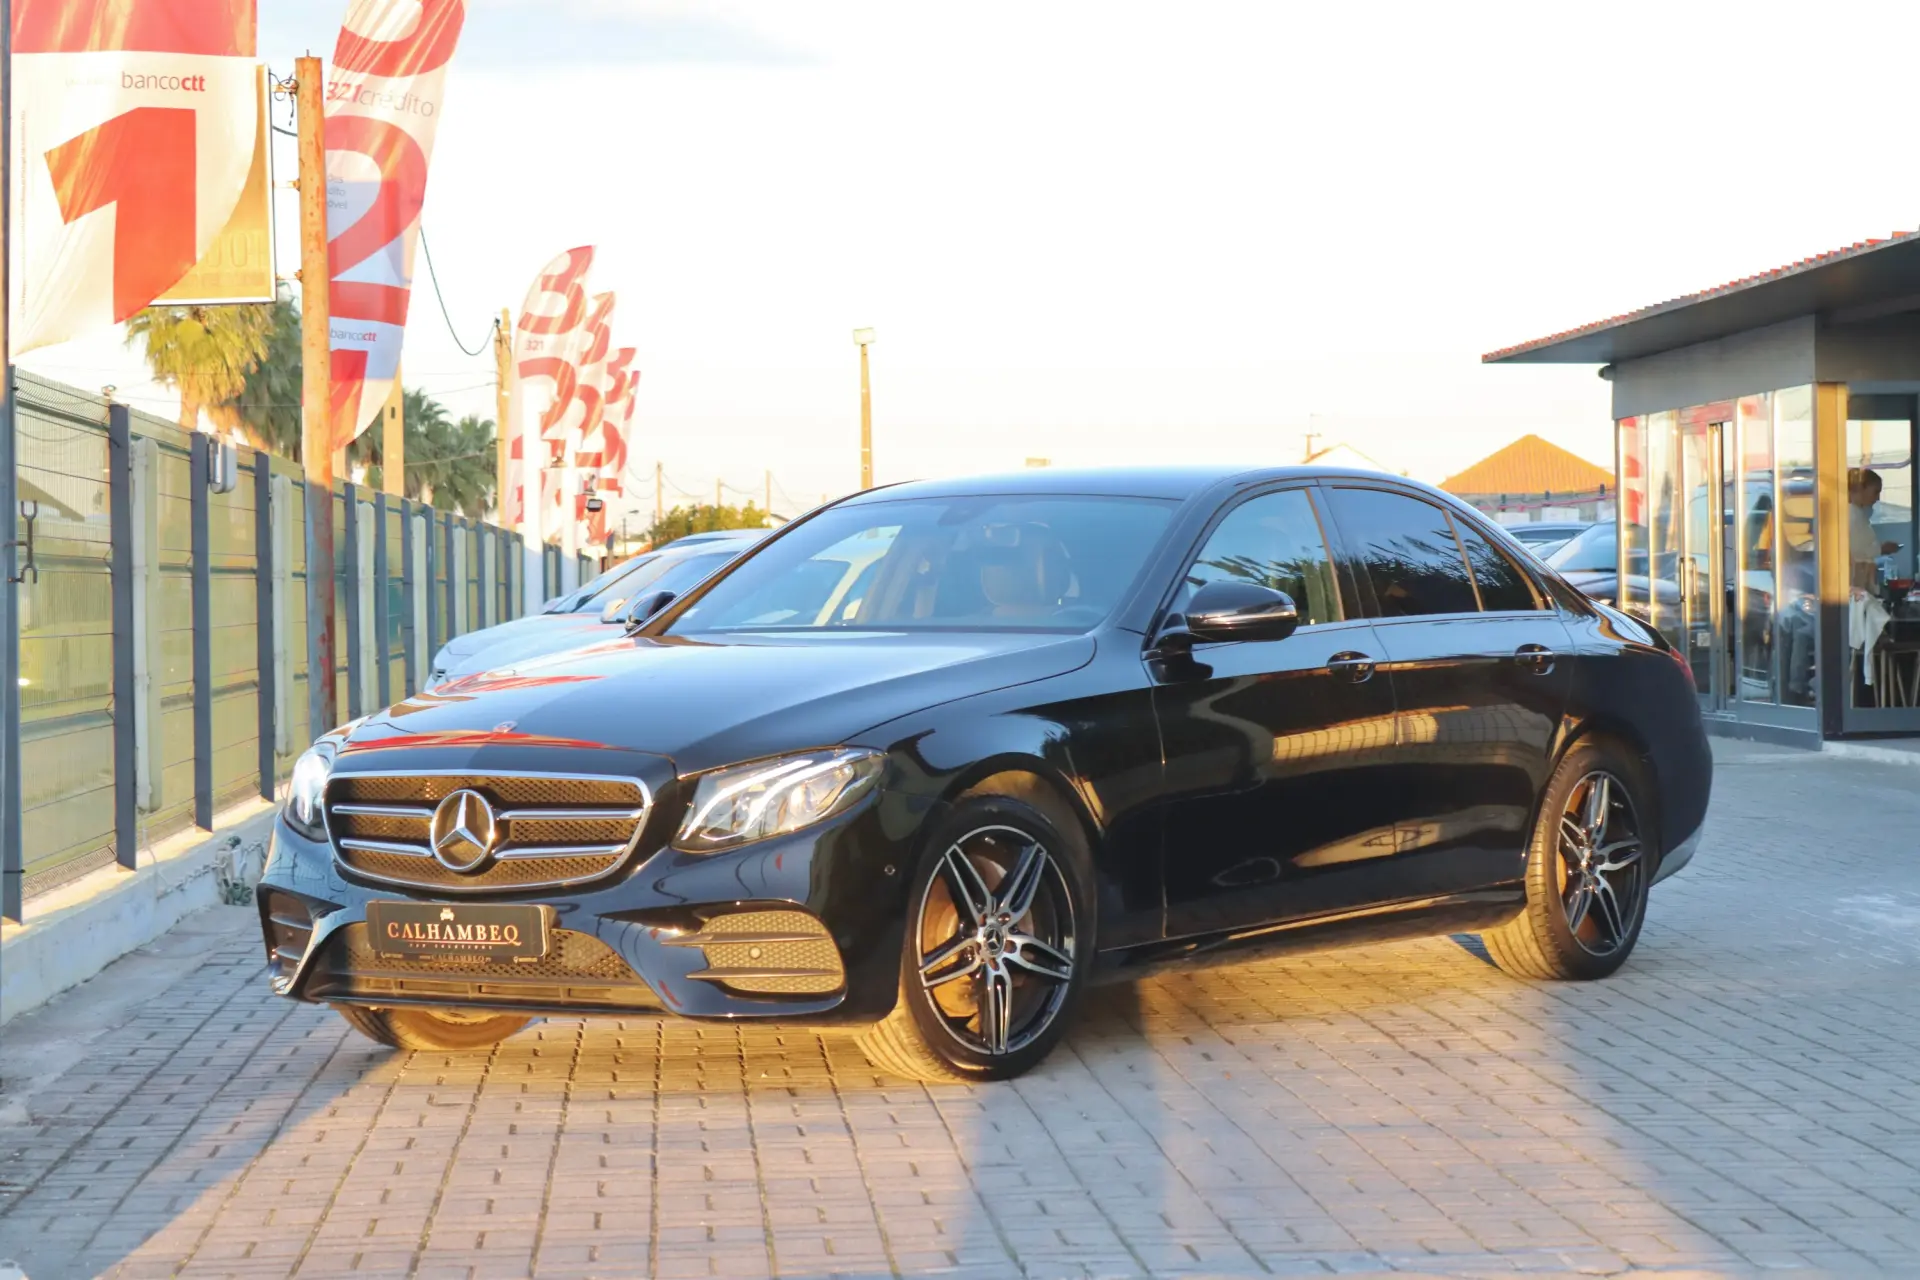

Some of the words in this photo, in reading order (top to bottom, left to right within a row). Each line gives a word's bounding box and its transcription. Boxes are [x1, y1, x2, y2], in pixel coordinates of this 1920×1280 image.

[121, 70, 206, 92] bancoctt
[326, 81, 435, 117] 321crédito
[329, 327, 378, 342] bancoctt
[387, 922, 522, 947] CALHAMBEQ
